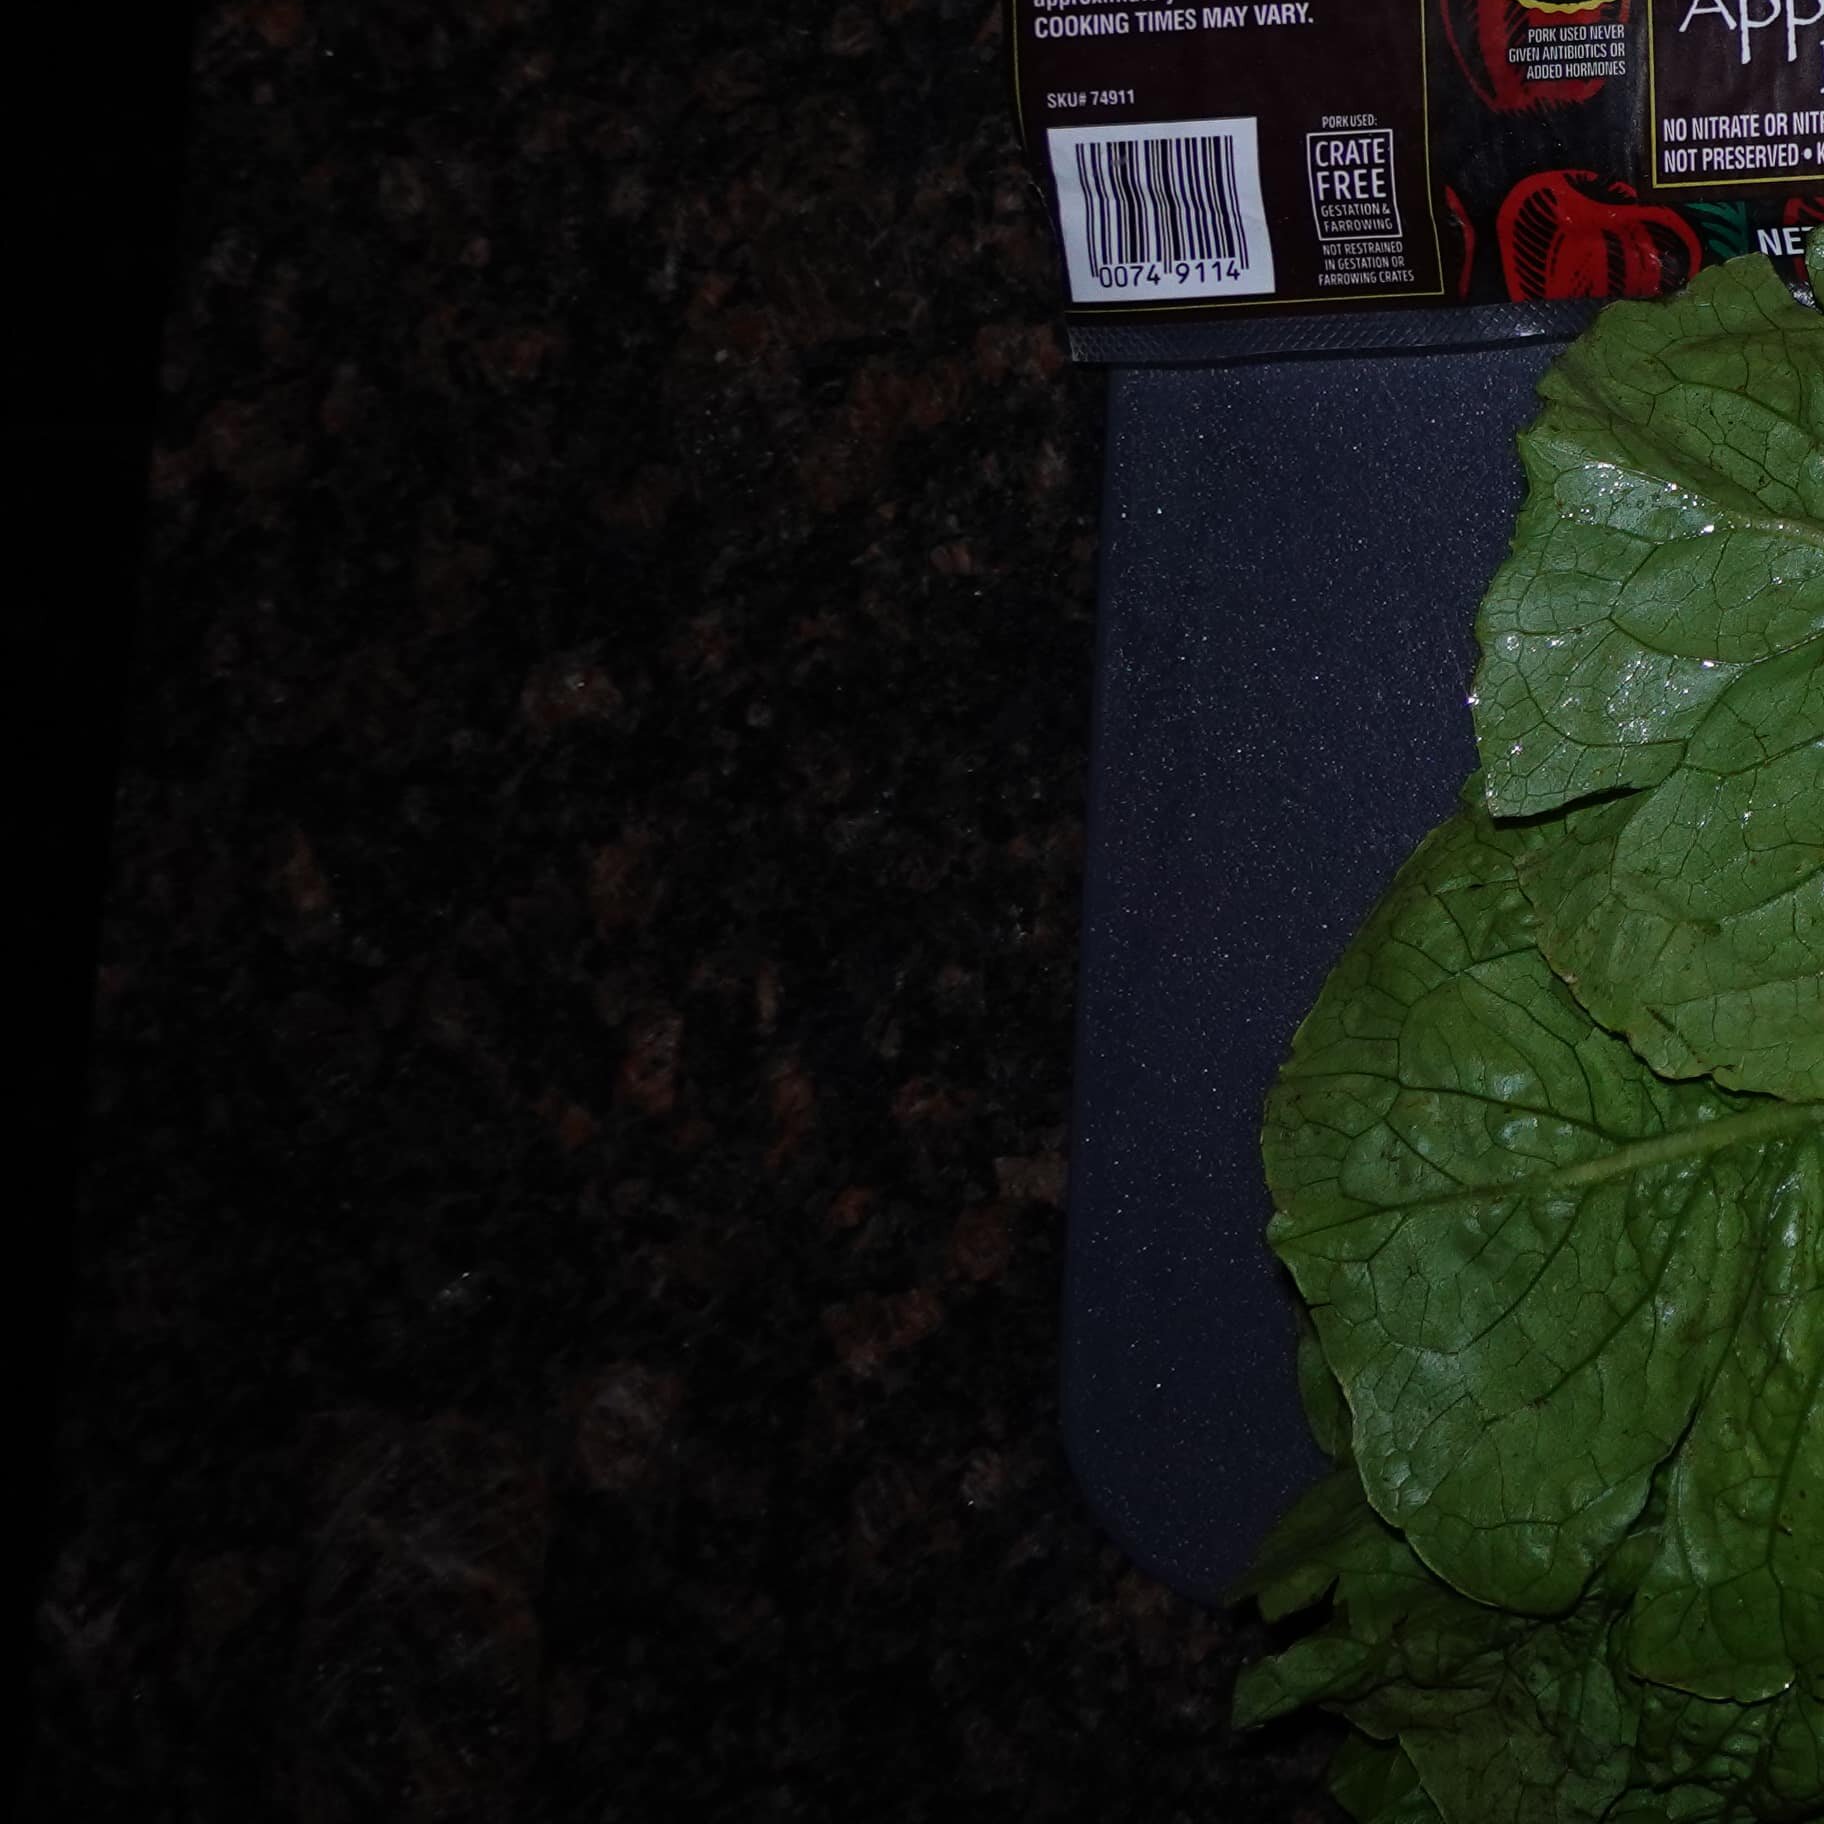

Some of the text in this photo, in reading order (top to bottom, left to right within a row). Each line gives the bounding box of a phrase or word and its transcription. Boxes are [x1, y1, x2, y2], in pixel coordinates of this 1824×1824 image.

[1034, 2, 1314, 40] COOKING TIMES MAY VARY.
[1664, 118, 1686, 142] NO
[1692, 113, 1761, 140] NITRATE
[1767, 111, 1788, 136] OR
[1315, 138, 1386, 167] CRATE
[1664, 148, 1697, 173] NOT
[1702, 143, 1800, 170] PRESERVED
[1317, 168, 1387, 201] FREE
[1100, 261, 1240, 288] 0074 9114
